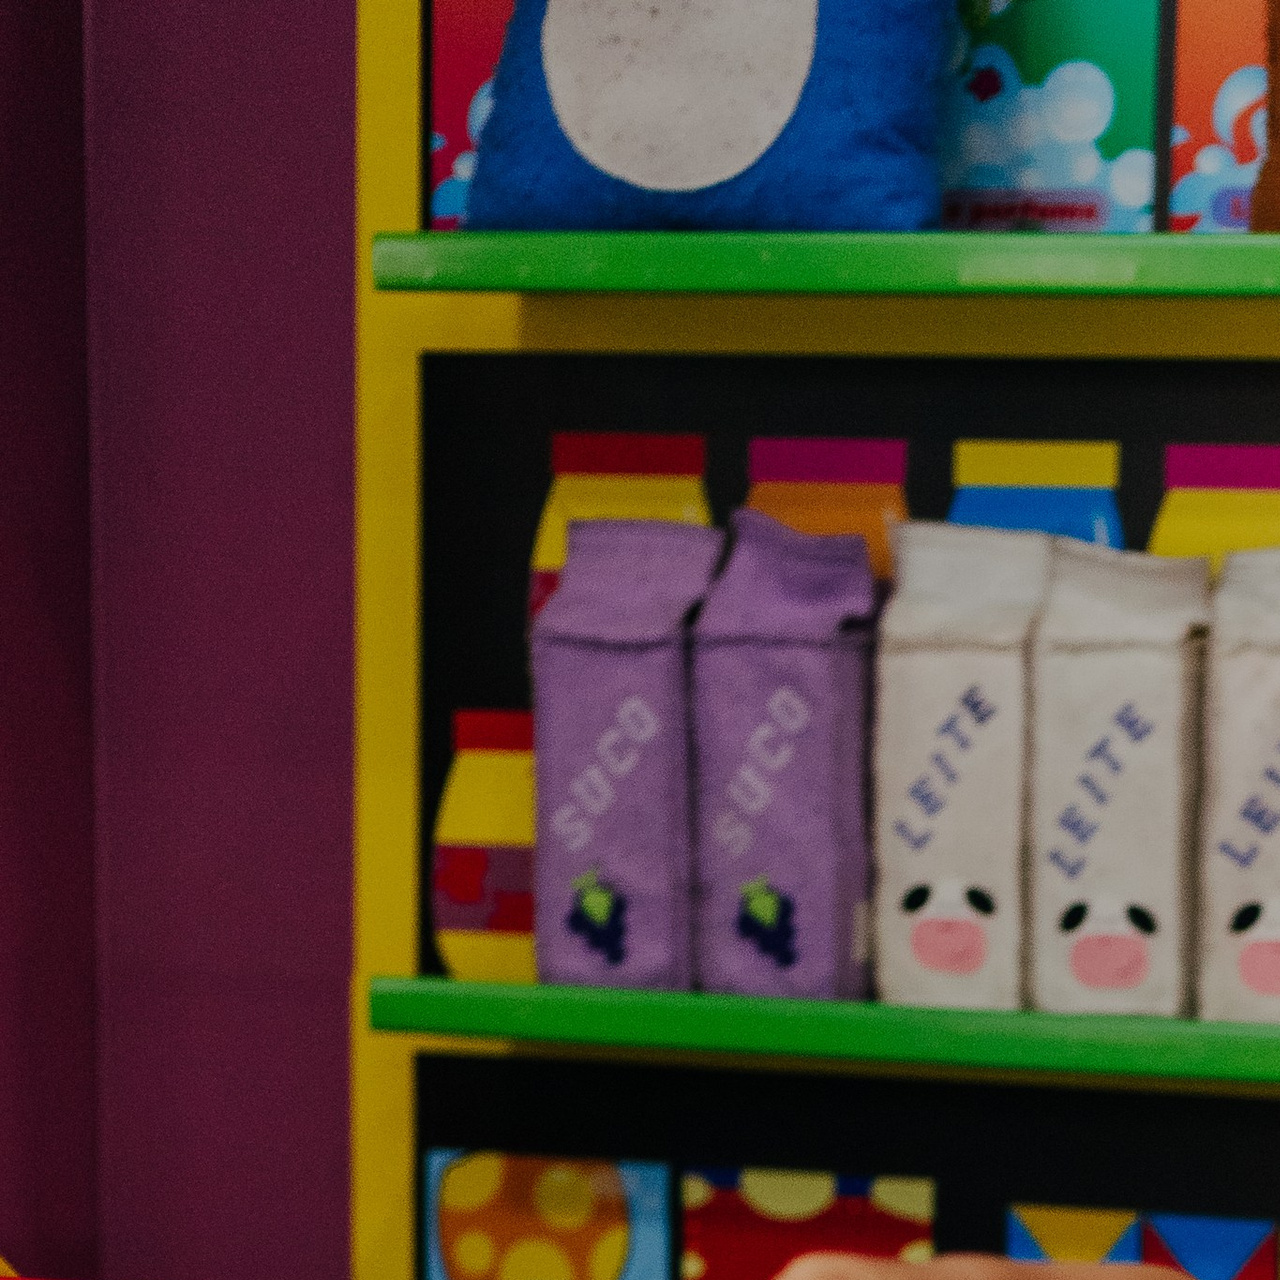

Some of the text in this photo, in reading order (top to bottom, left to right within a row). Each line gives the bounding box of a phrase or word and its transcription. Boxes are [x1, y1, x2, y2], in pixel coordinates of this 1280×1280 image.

[551, 697, 659, 851] SUCO
[712, 687, 811, 856] SUCO
[895, 684, 995, 849] LEITE
[1049, 702, 1154, 879] LEITE
